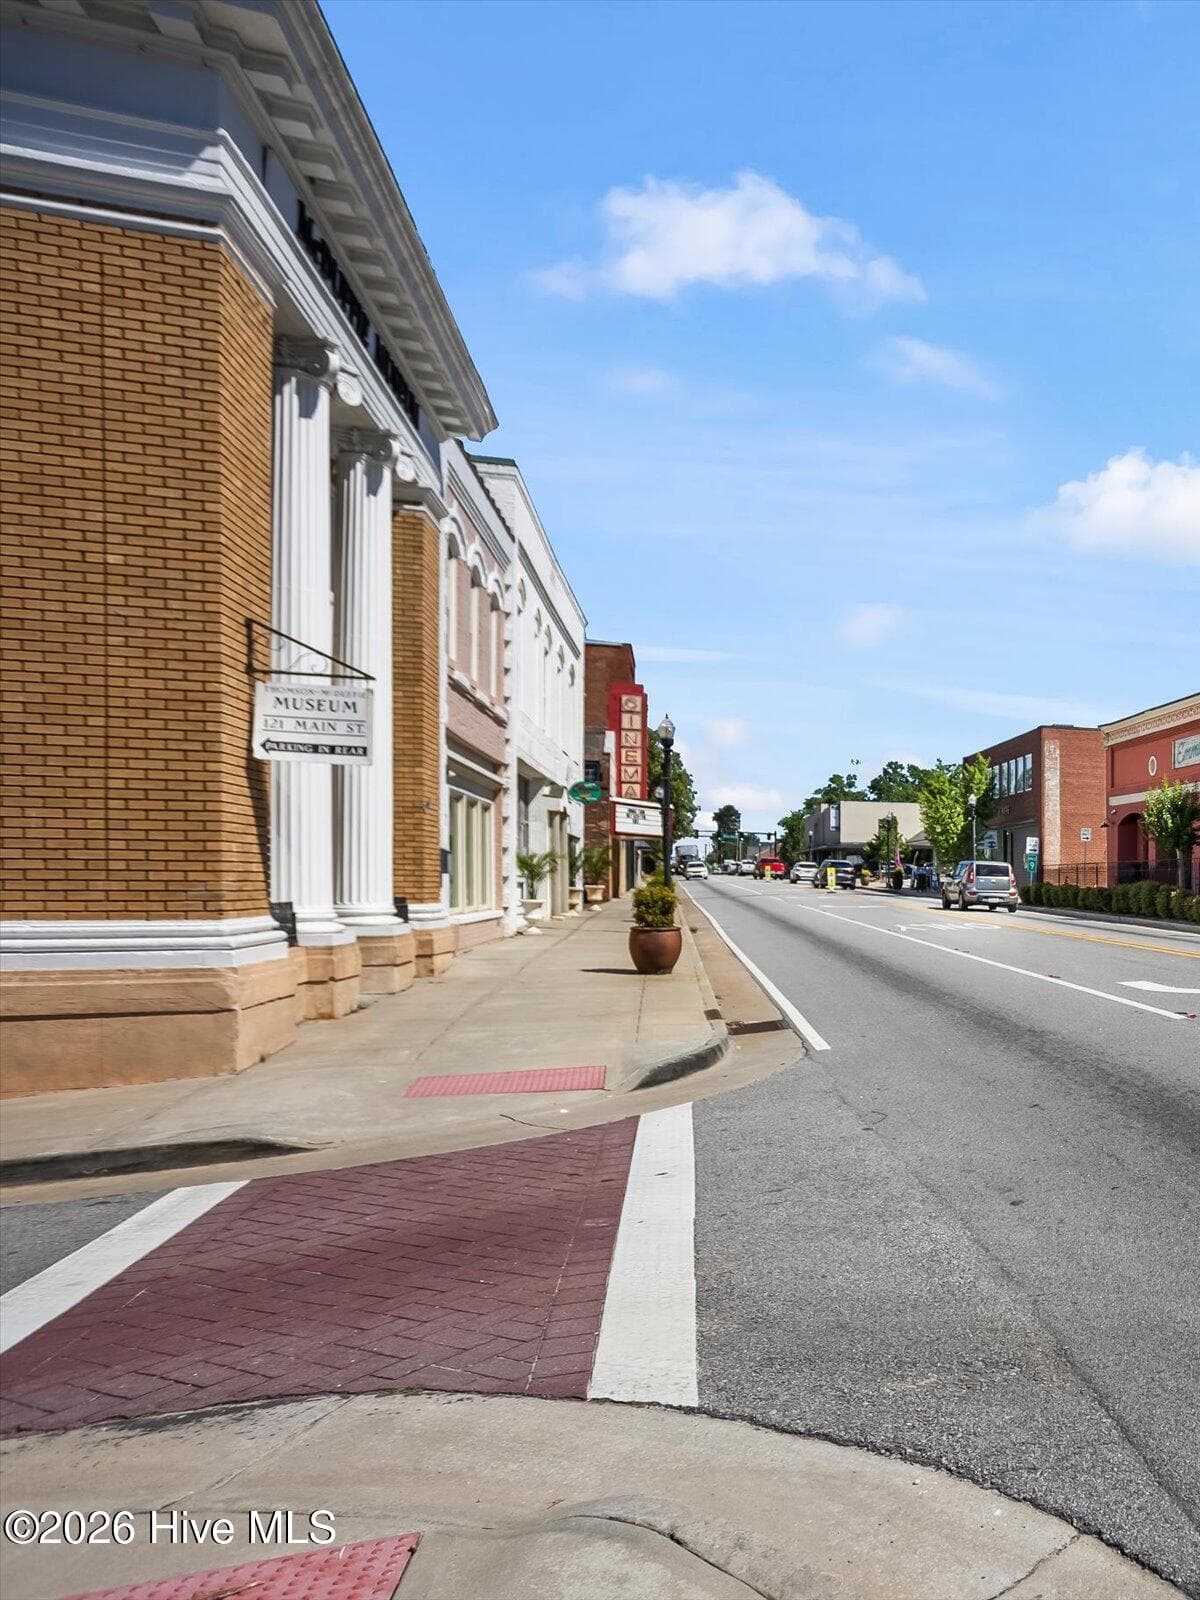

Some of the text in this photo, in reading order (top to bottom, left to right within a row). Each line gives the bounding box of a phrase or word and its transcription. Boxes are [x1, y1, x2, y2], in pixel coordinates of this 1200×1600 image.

[273, 696, 358, 714] MUSEUM
[263, 717, 284, 730] 121
[294, 719, 337, 732] MAIN
[264, 741, 365, 756] PARKING IN REAR
